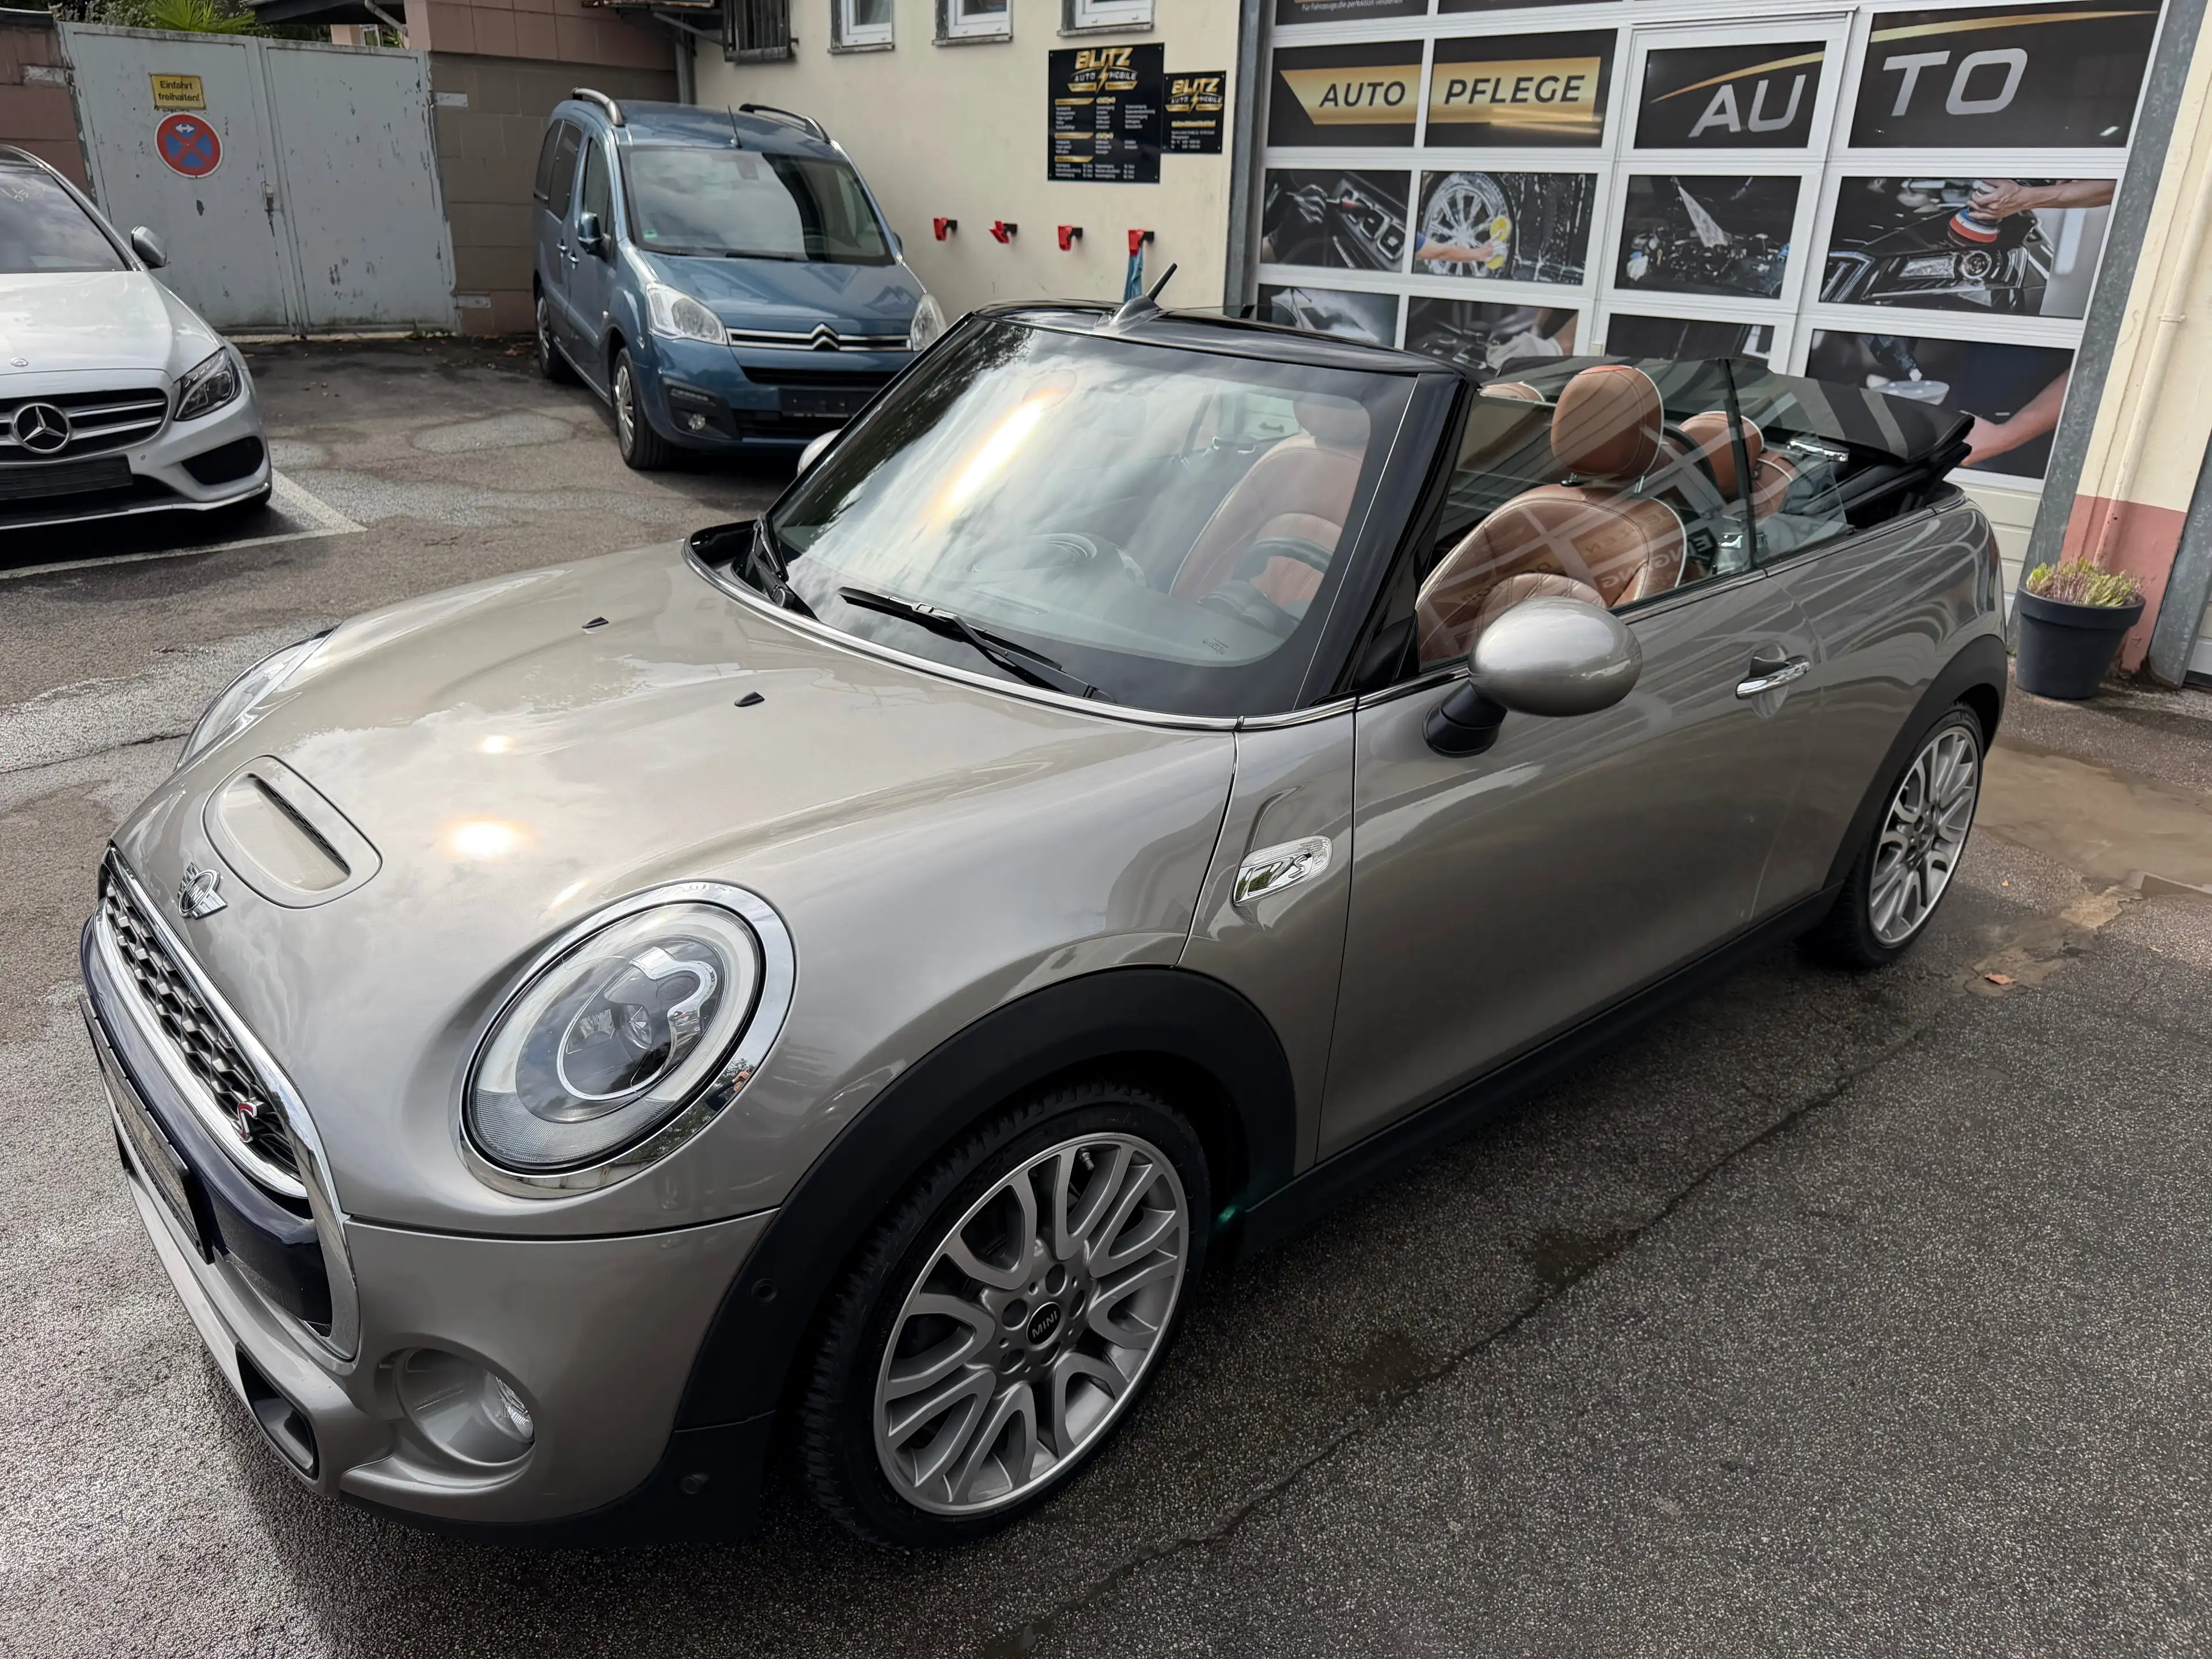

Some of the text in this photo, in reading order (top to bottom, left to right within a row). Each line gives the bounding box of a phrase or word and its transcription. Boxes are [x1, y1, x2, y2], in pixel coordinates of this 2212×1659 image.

[1075, 47, 1134, 70] BLITZ
[1074, 71, 1137, 82] AUTO MOBILE
[160, 80, 192, 90] Einfahrt
[1171, 78, 1220, 94] BLITZ
[1319, 75, 1585, 108] AUTO PFLEGE
[158, 92, 200, 102] freihalten!
[1032, 1310, 1058, 1338] MINI
